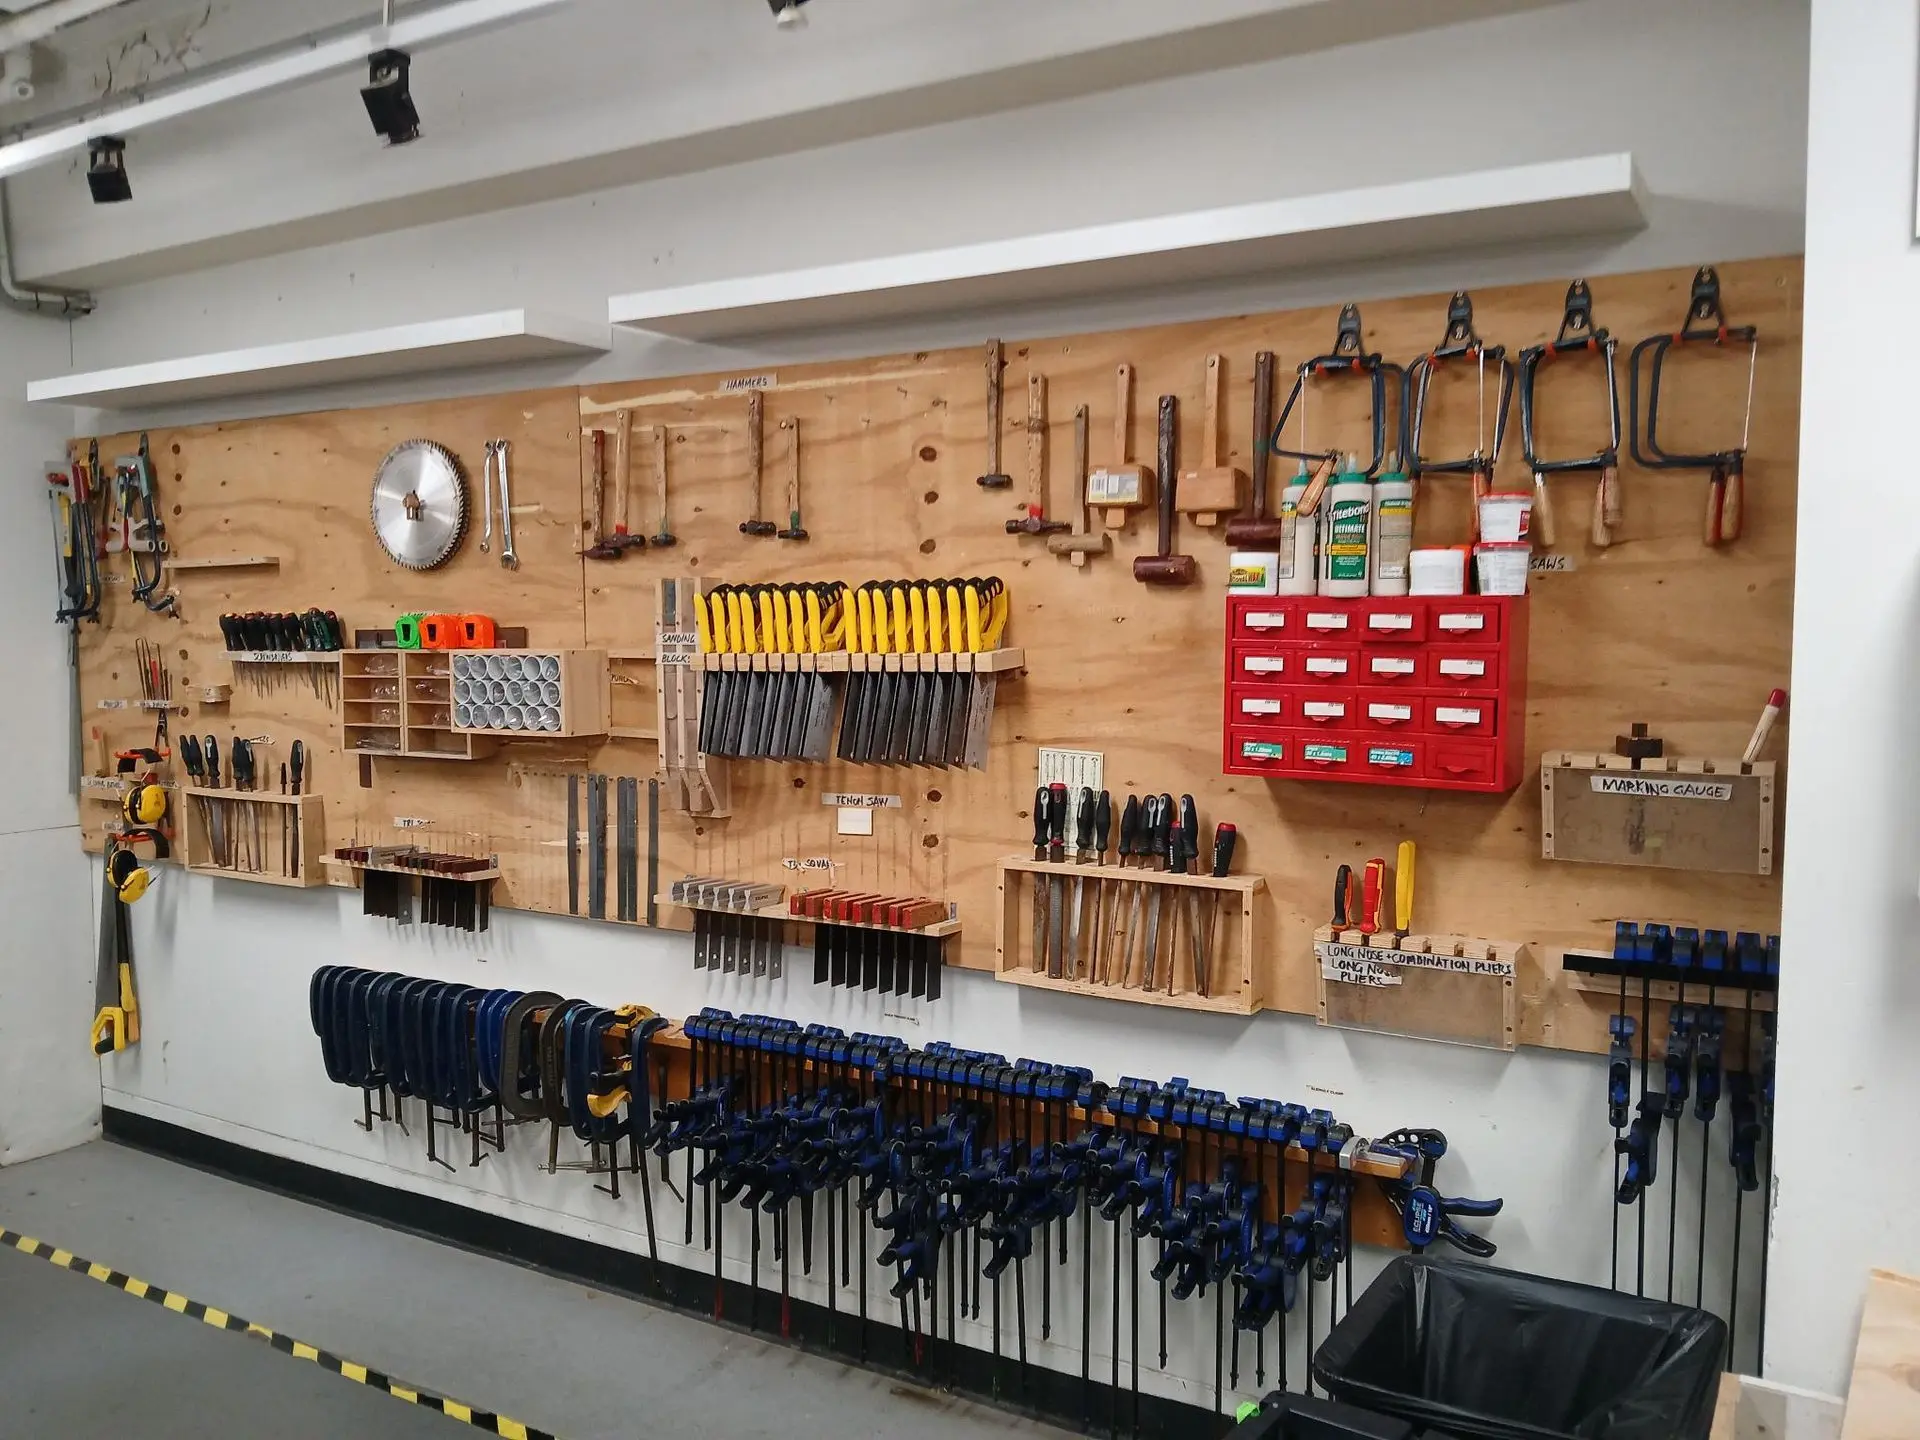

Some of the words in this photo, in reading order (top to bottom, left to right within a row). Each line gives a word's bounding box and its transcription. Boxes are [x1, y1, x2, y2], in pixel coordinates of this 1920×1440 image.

[726, 376, 768, 390] HAMMERS
[1334, 524, 1366, 534] ULTIMATE
[1530, 556, 1565, 570] SAWS
[661, 633, 696, 644] SANDING
[1602, 778, 1669, 796] MARKING
[1673, 783, 1725, 798] GAUGE
[835, 795, 864, 806] TENON
[866, 796, 889, 807] SAW
[1327, 944, 1354, 958] LONG
[1357, 947, 1384, 961] NOSE
[1475, 961, 1512, 975] PLIERS
[1331, 957, 1364, 974] LONG
[1341, 971, 1383, 986] PLIERS
[1412, 1202, 1422, 1232] ECLIPSE
